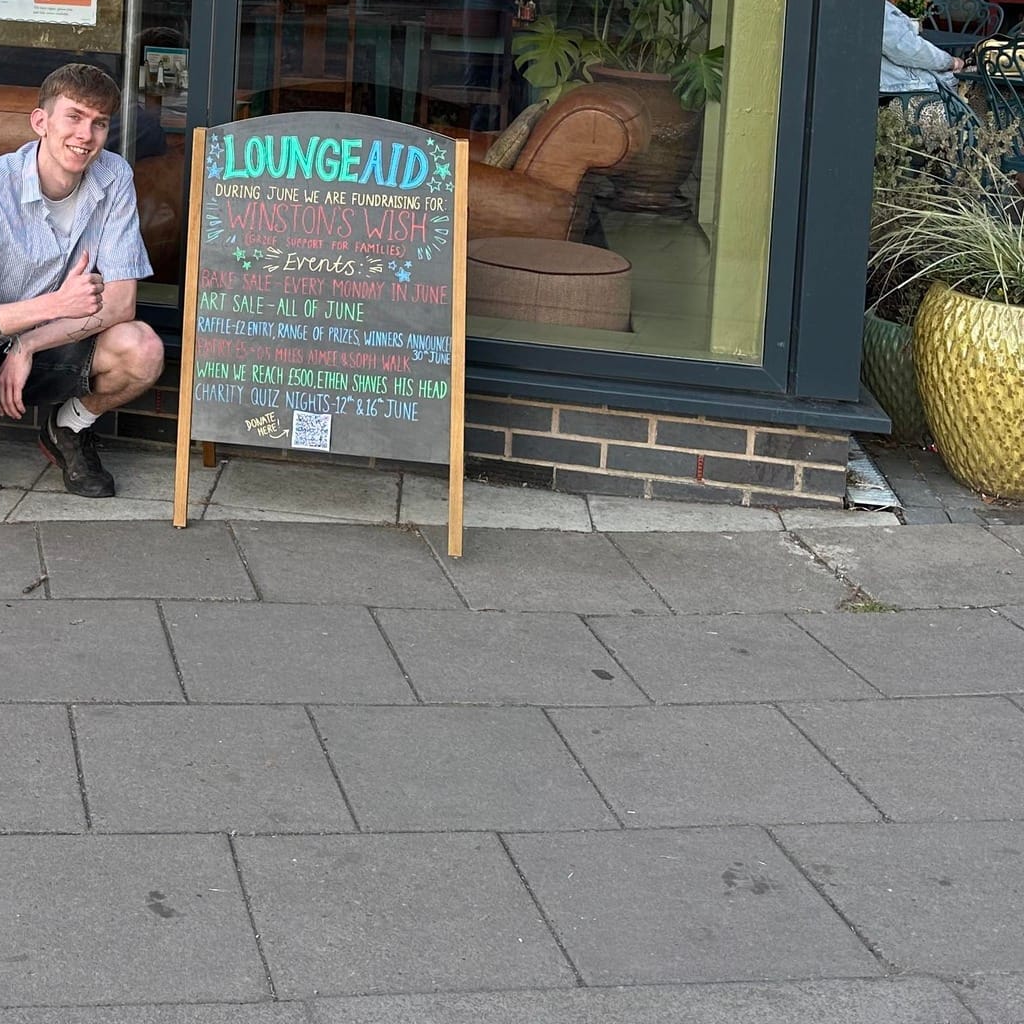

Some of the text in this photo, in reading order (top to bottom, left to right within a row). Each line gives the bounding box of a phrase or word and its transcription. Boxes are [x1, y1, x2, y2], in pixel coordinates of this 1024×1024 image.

[216, 183, 261, 200] DURING
[266, 186, 299, 202] JUNE
[303, 189, 320, 204] WE
[324, 191, 346, 205] ARE
[351, 193, 421, 211] FUNDRAISING
[226, 199, 429, 243] WINSTON'S WISH
[286, 237, 324, 249] SUPPORT
[332, 240, 349, 251] FOR
[355, 241, 407, 258] FAMILIES)
[201, 268, 236, 291] BAKE
[284, 275, 325, 296] EVERY
[332, 279, 385, 301] MONDAY
[391, 282, 408, 303] IN
[411, 283, 449, 306] JUNE
[200, 291, 227, 311] ART
[232, 294, 264, 315] SALE
[276, 297, 298, 317] ALL
[303, 298, 319, 319] OF
[324, 300, 364, 323] JUNE
[277, 322, 308, 341] RANGE
[312, 326, 324, 341] OF
[363, 330, 404, 348] WINNERS
[382, 354, 411, 373] WALK
[428, 350, 451, 365] JUNE
[196, 361, 229, 379] WHEN
[233, 363, 247, 382] WE
[252, 364, 284, 385] REACH
[352, 373, 388, 394] SHAVES
[394, 377, 414, 397] HIS
[418, 379, 448, 400] HEAD
[195, 382, 244, 405] CHARITY
[250, 386, 280, 408] QUIZ
[384, 398, 419, 422] JUNE
[245, 411, 275, 432] DONATE
